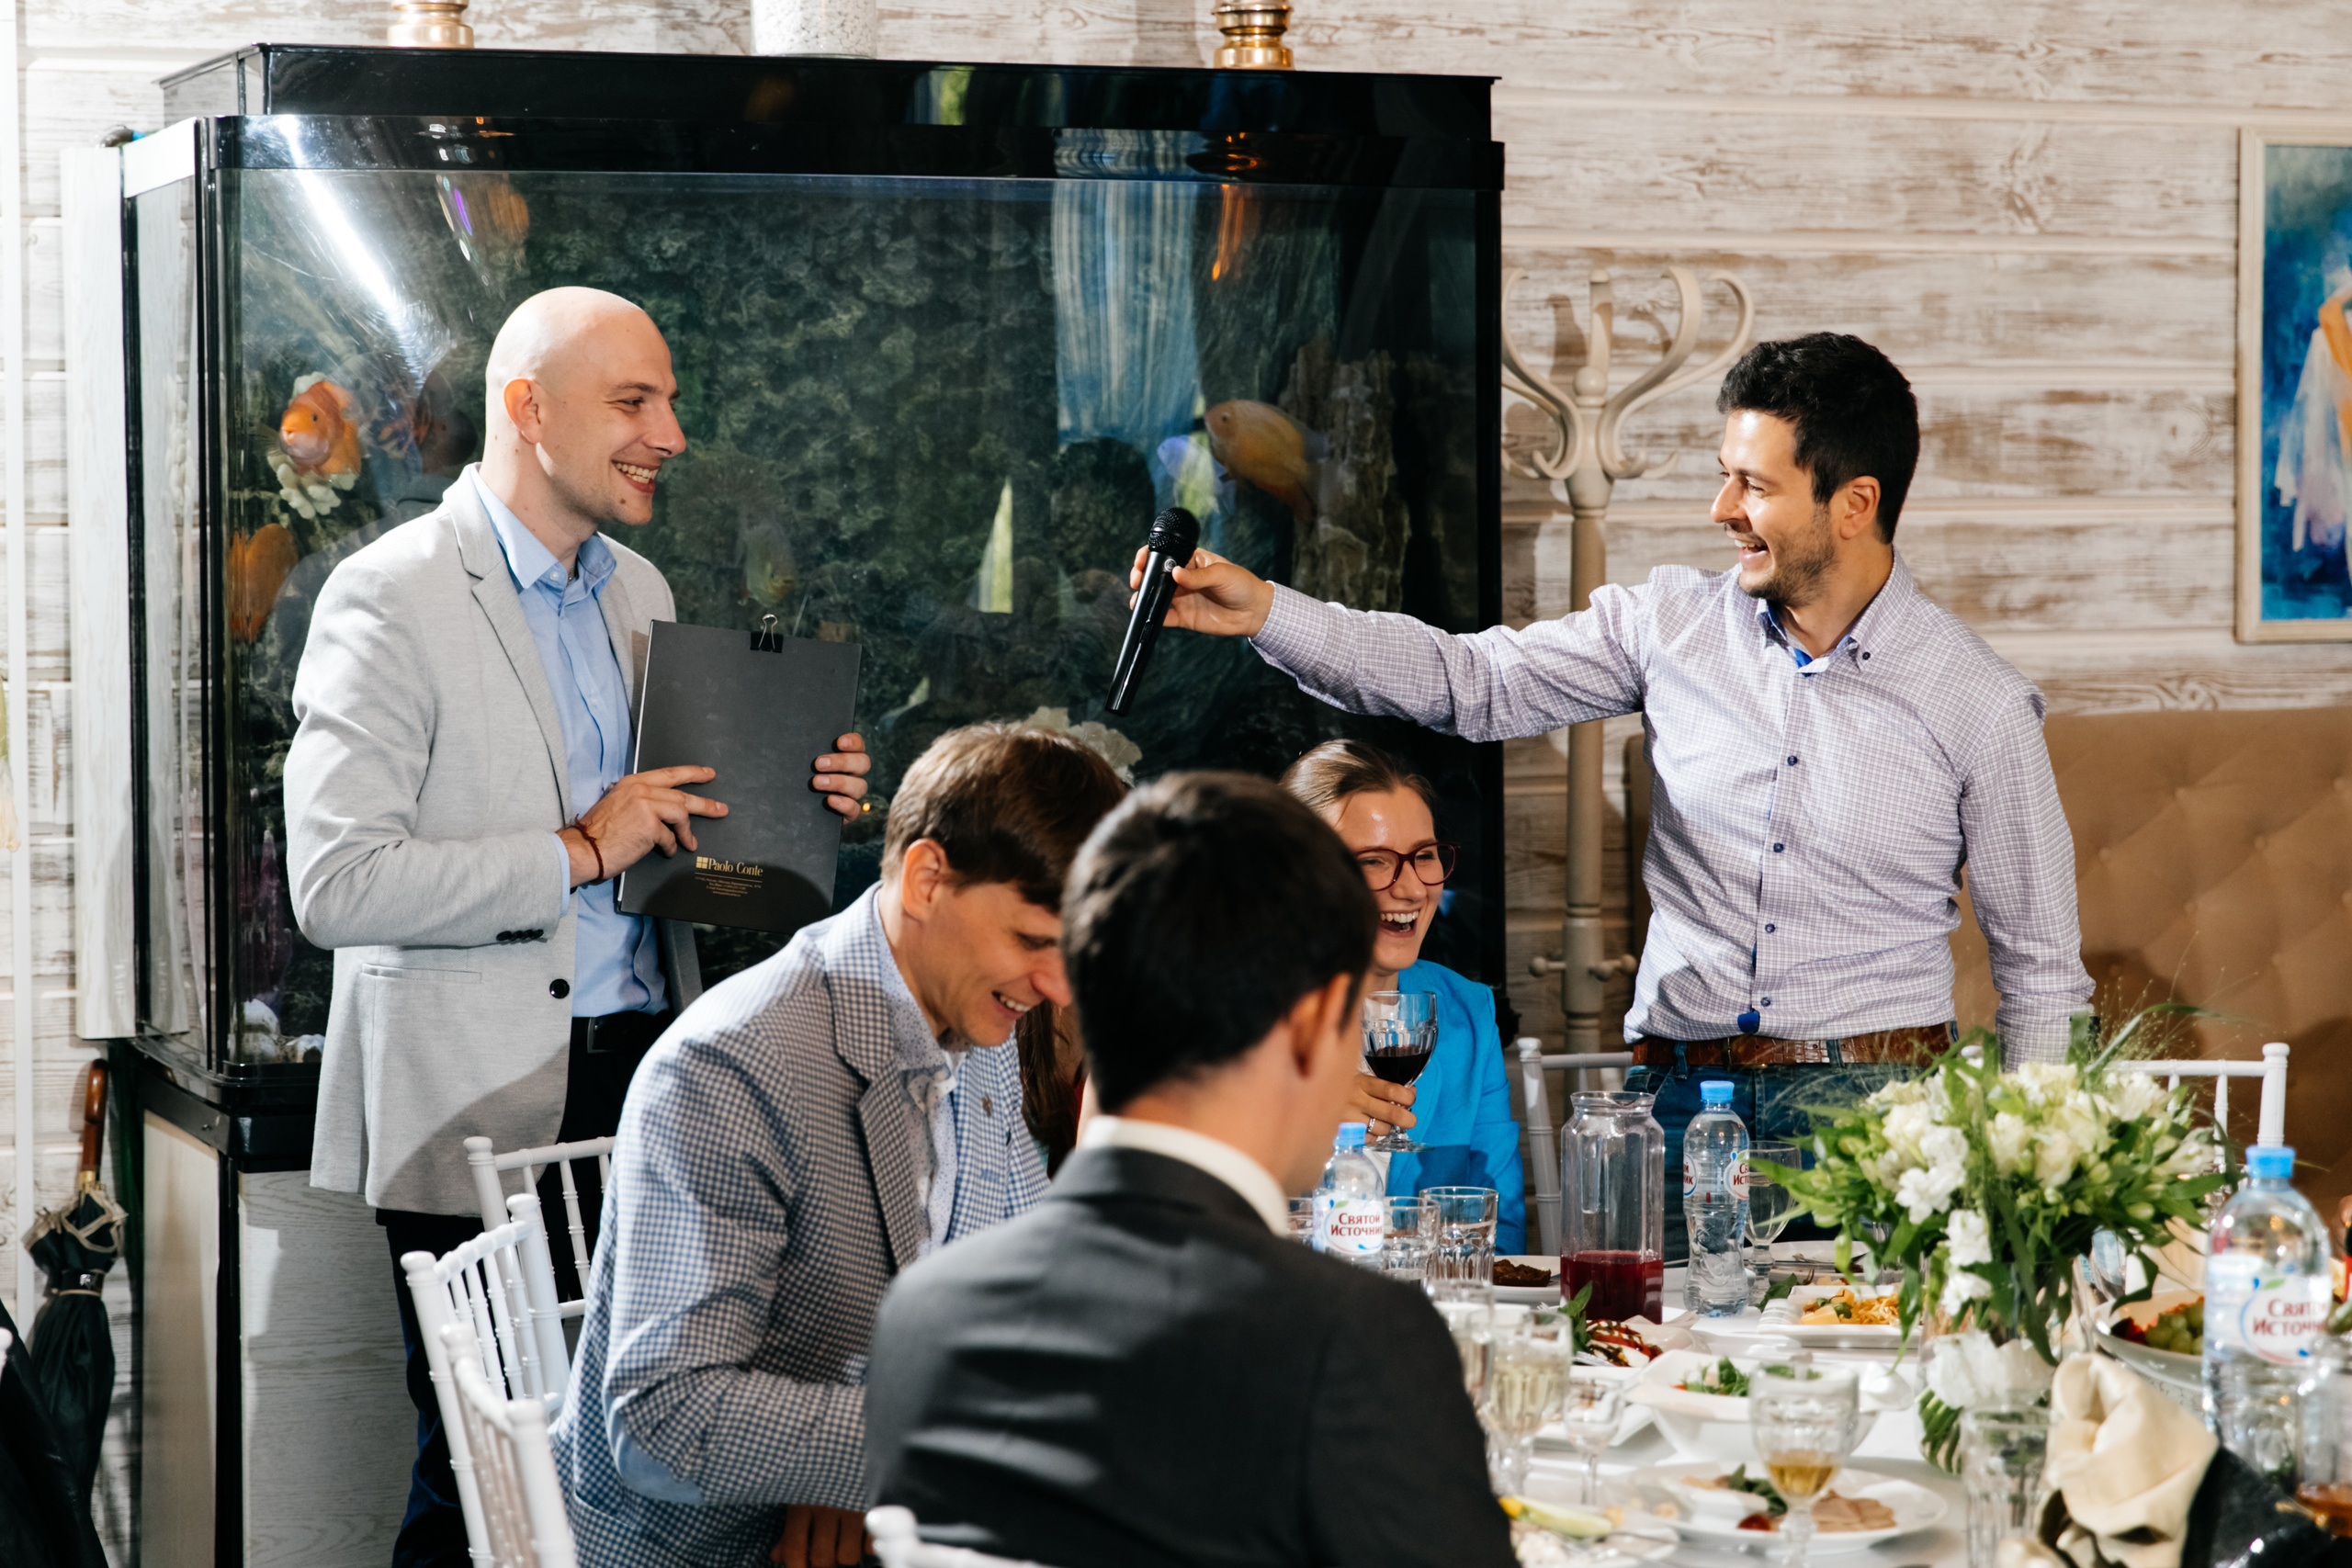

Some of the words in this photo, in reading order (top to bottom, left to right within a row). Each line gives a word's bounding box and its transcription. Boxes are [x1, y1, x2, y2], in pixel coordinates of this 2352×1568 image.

[708, 858, 734, 873] Paolo
[736, 862, 763, 877] Conte
[1339, 1212, 1380, 1225] Святой
